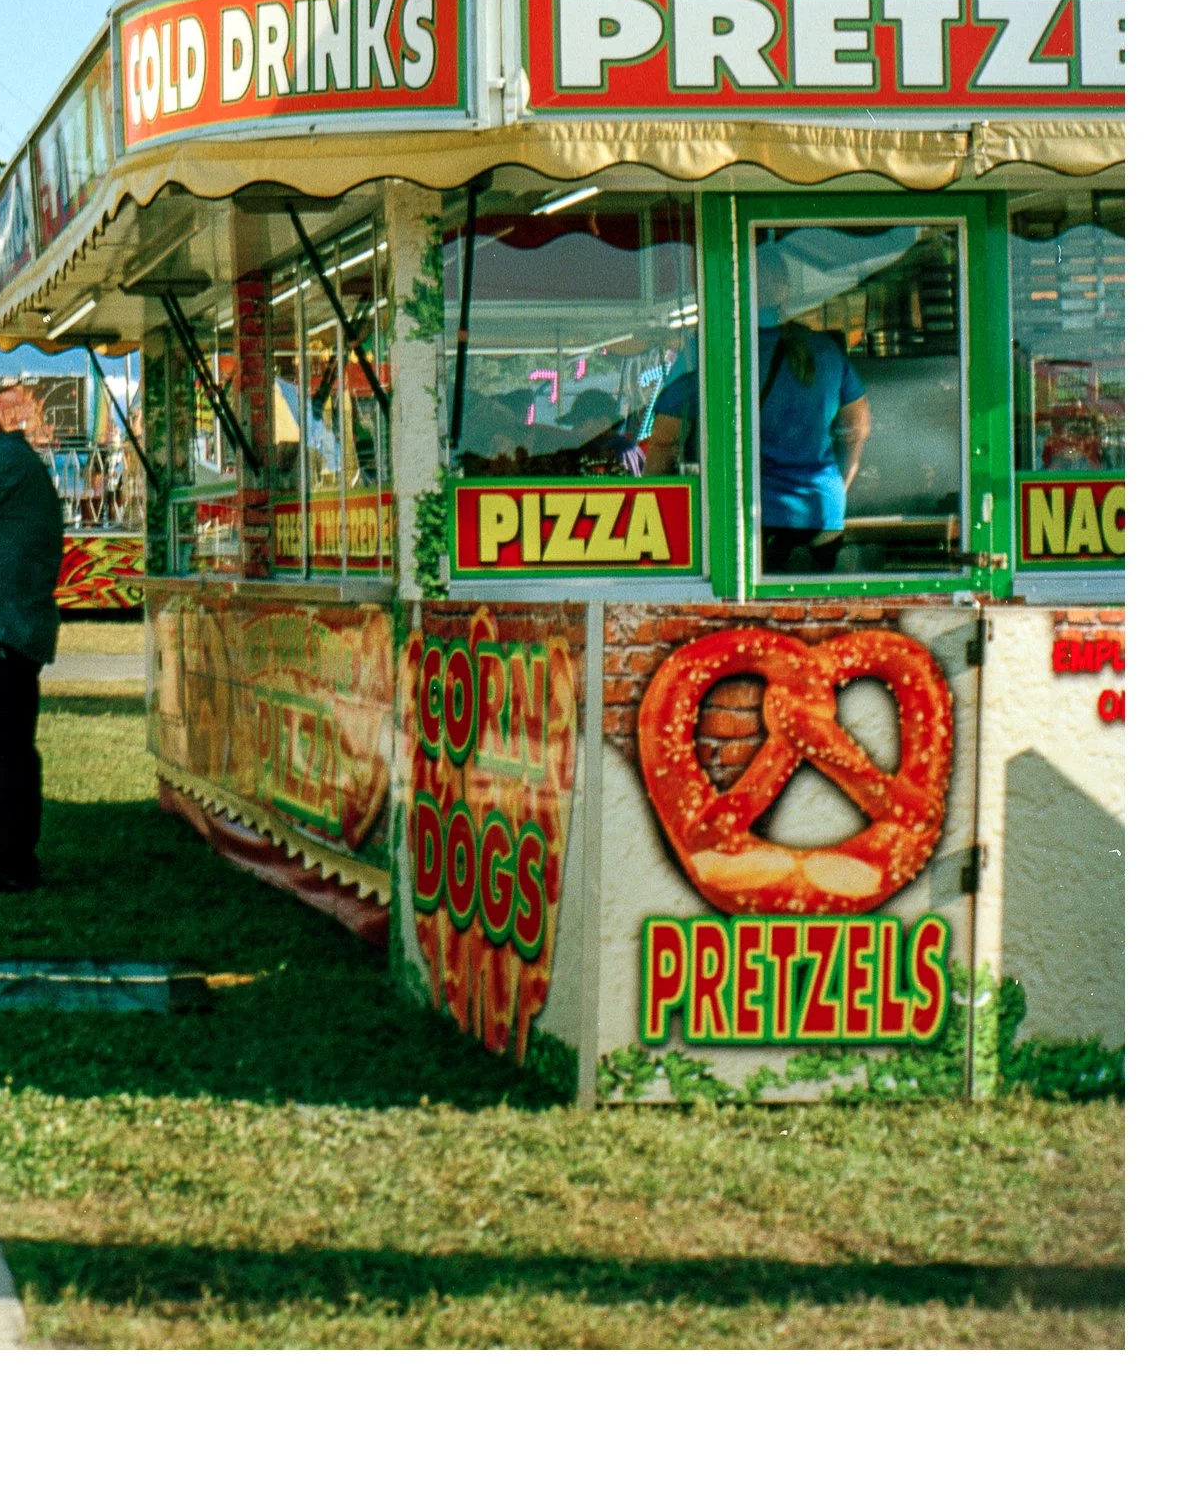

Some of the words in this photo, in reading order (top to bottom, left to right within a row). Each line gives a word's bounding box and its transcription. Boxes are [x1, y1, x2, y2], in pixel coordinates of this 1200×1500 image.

[129, 15, 208, 128] COLD
[478, 491, 671, 564] PIZZA
[415, 636, 549, 782] CORN
[1097, 688, 1125, 723] O
[413, 791, 548, 961] DOGS
[641, 914, 951, 1044] PRETZELS
